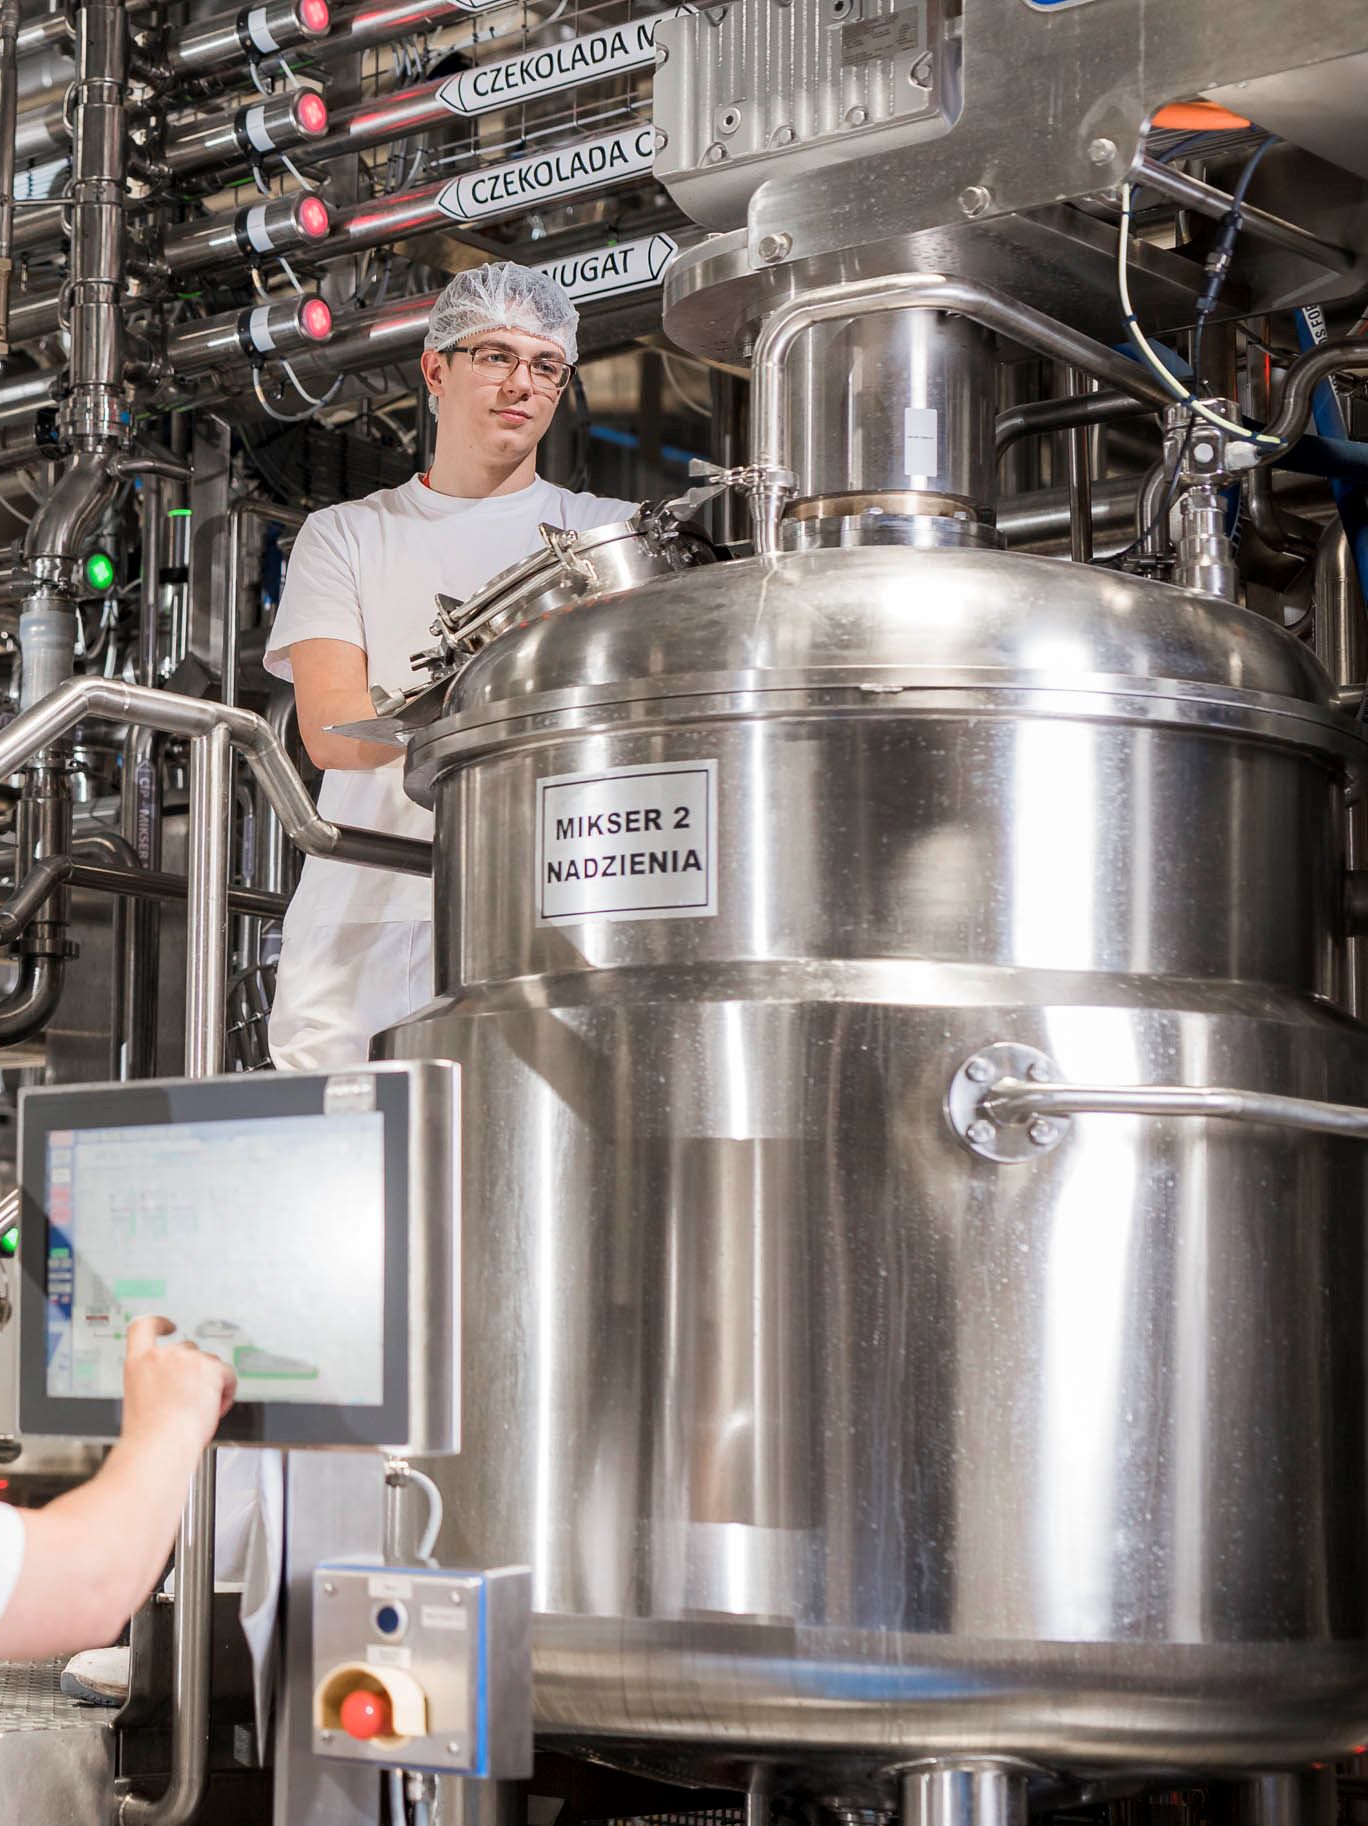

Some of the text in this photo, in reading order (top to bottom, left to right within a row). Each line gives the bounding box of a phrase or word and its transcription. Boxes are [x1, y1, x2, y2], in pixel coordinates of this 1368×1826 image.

[473, 31, 630, 97] CZEKOLADA
[471, 140, 629, 204] CZEKOLADA
[556, 806, 690, 841] MIKSER 2
[547, 849, 703, 884] NADZIENIA
